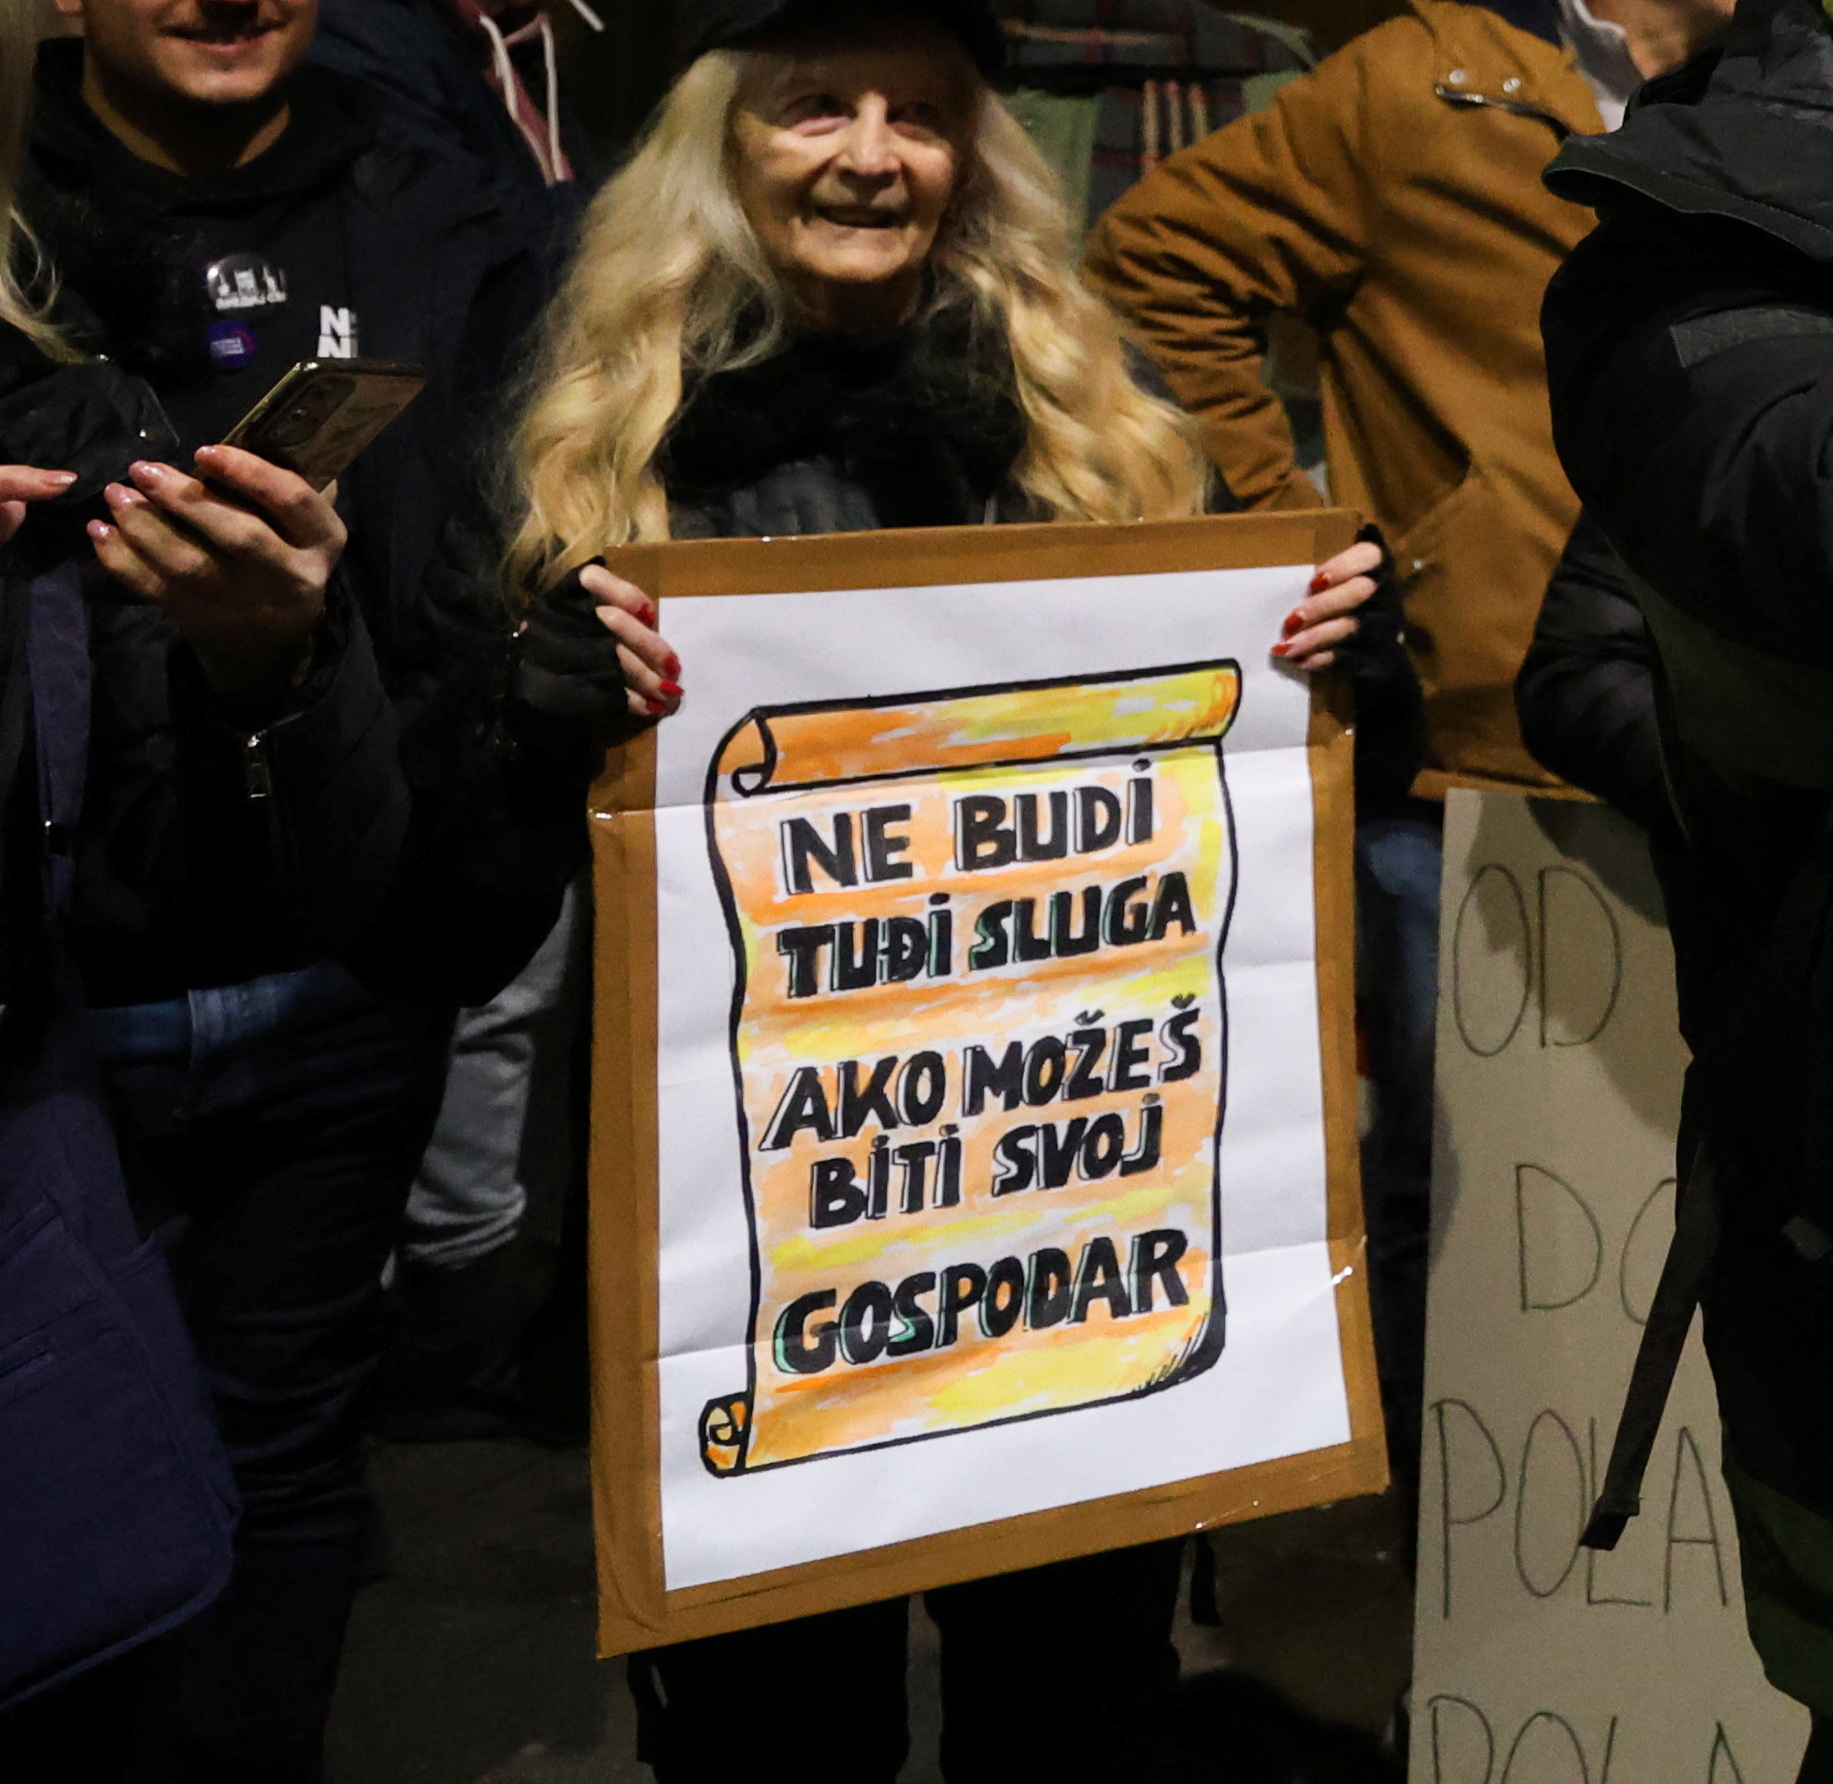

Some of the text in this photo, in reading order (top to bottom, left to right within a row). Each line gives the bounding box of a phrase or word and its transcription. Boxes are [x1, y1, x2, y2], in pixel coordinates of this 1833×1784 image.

[780, 804, 913, 896] NE
[968, 871, 1198, 972] SLUGA
[1453, 864, 1622, 1057] OD
[758, 993, 1202, 1151] AKO MOŽEŠ
[991, 1092, 1164, 1198] SVOJ
[772, 1228, 1190, 1375] GOSPODAR
